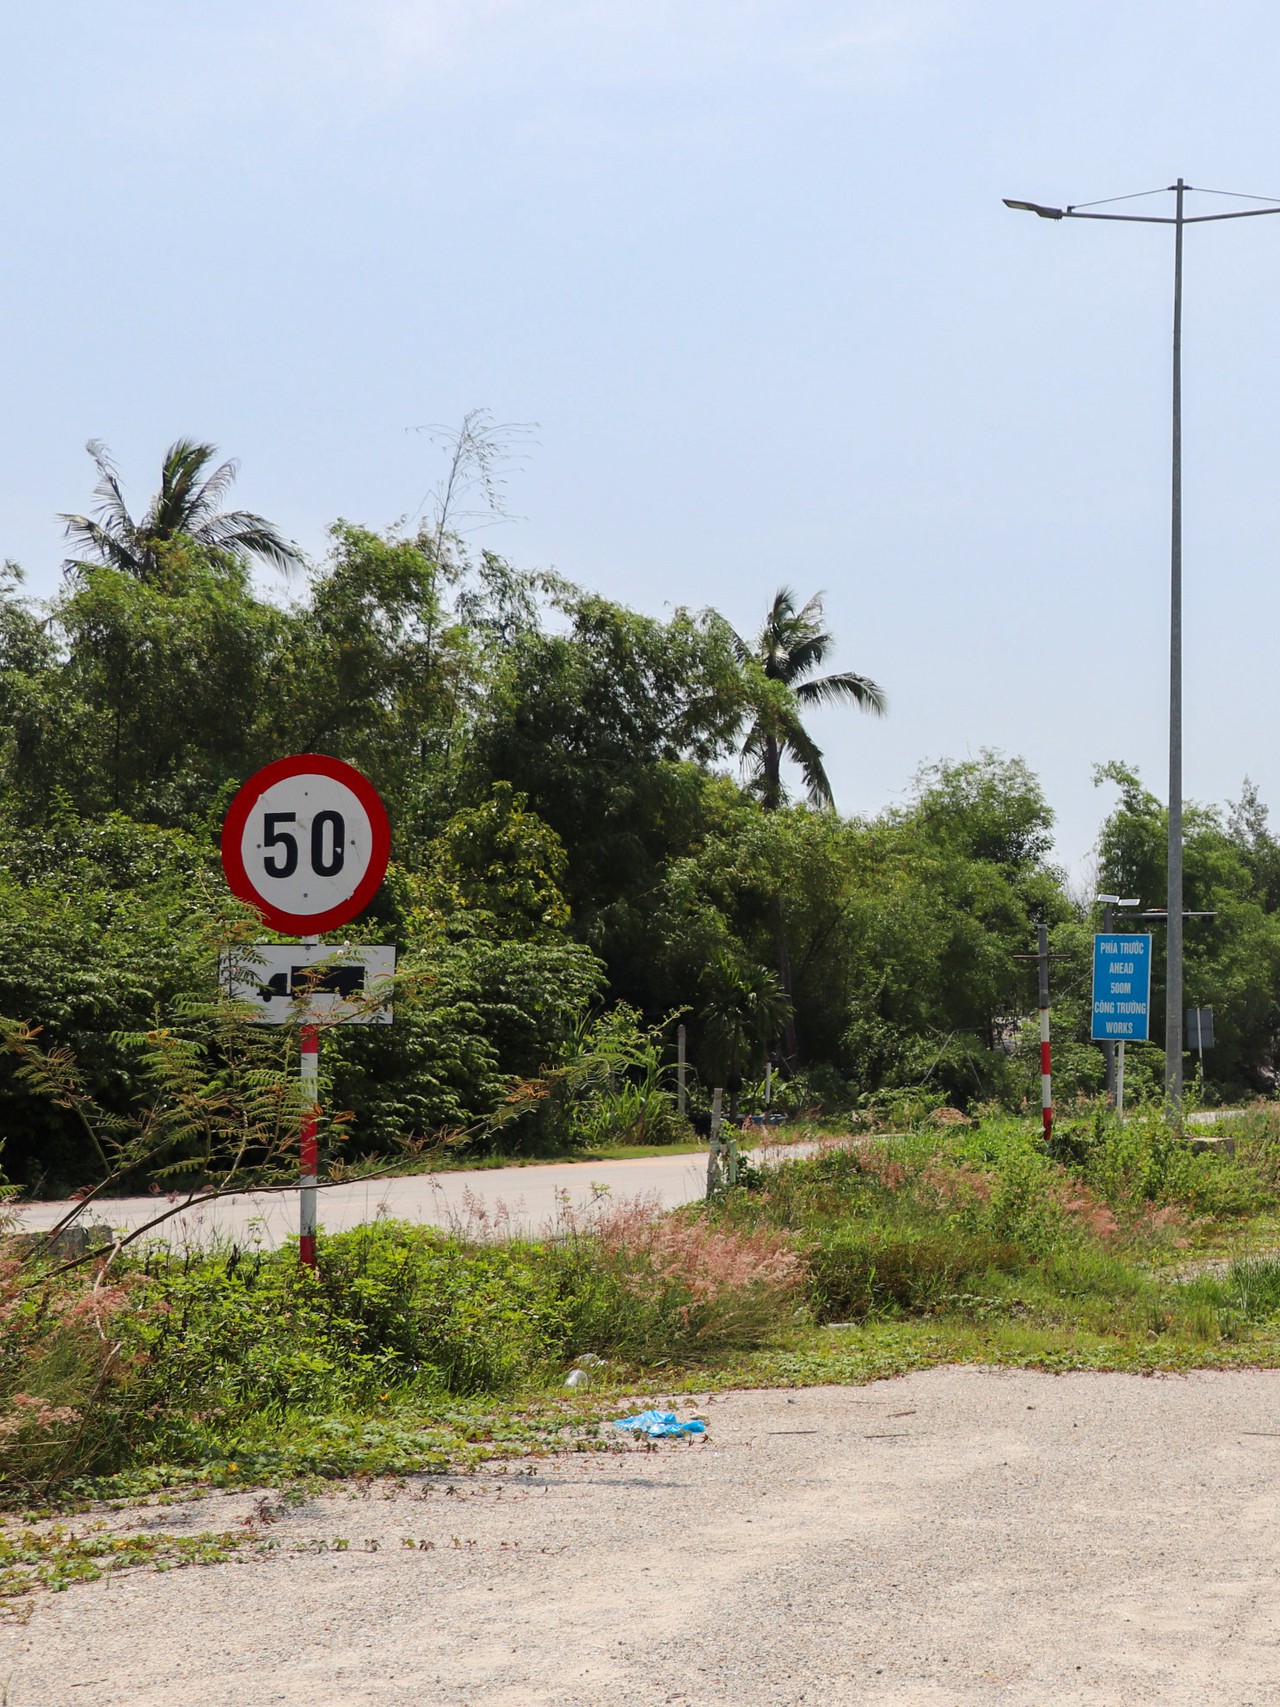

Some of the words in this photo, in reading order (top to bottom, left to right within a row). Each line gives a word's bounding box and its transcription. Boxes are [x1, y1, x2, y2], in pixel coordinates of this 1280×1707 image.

[263, 810, 345, 878] 50
[1109, 962, 1134, 974] AHEAD
[1110, 982, 1131, 994] 500M
[1094, 1000, 1115, 1013] CÔNG
[1105, 1022, 1133, 1034] WORKS
